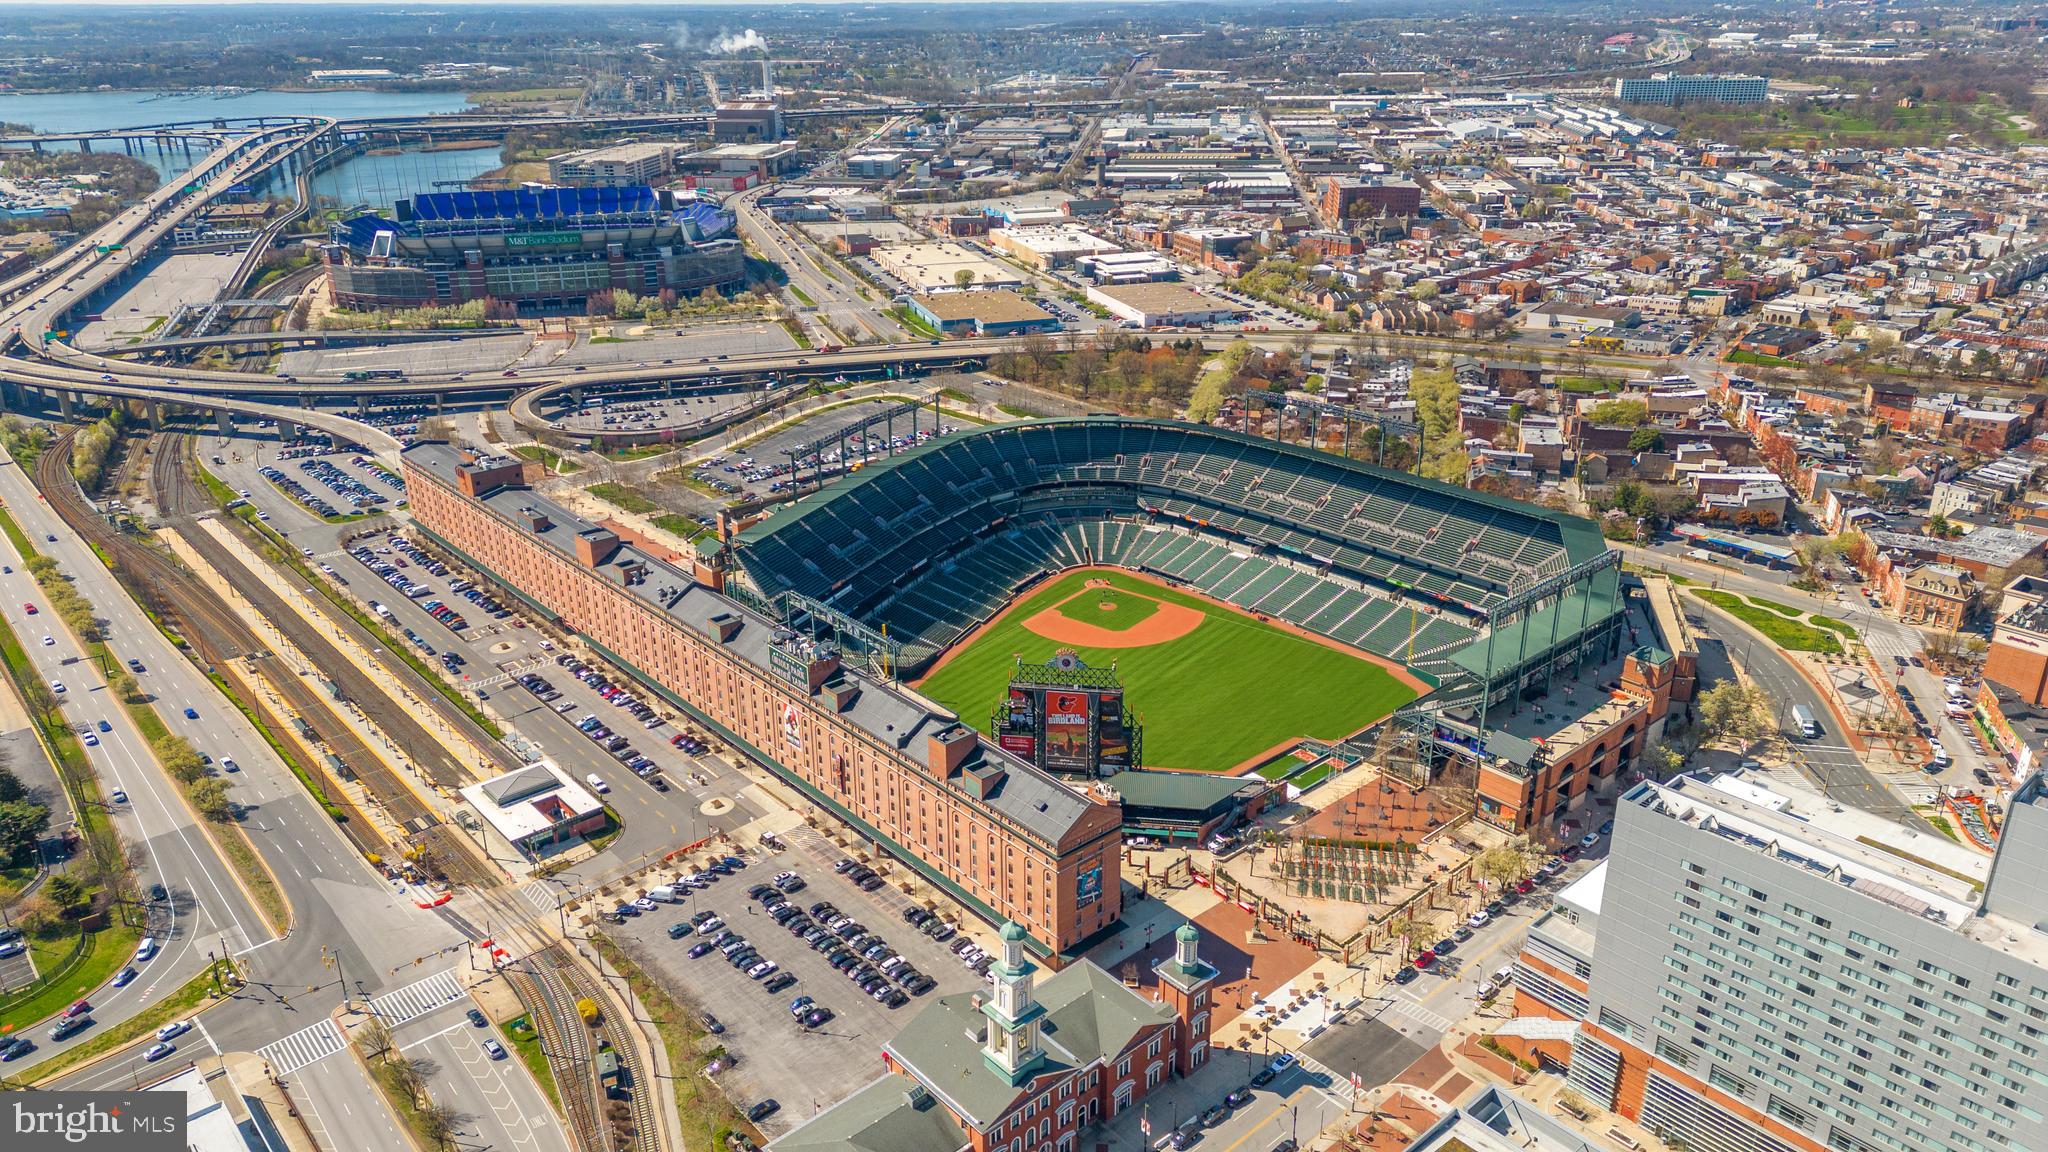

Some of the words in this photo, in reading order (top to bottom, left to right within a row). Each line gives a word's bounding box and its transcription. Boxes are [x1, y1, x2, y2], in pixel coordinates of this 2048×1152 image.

[508, 237, 527, 246] M&T
[528, 236, 546, 245] Bank
[548, 234, 579, 244] Stadium
